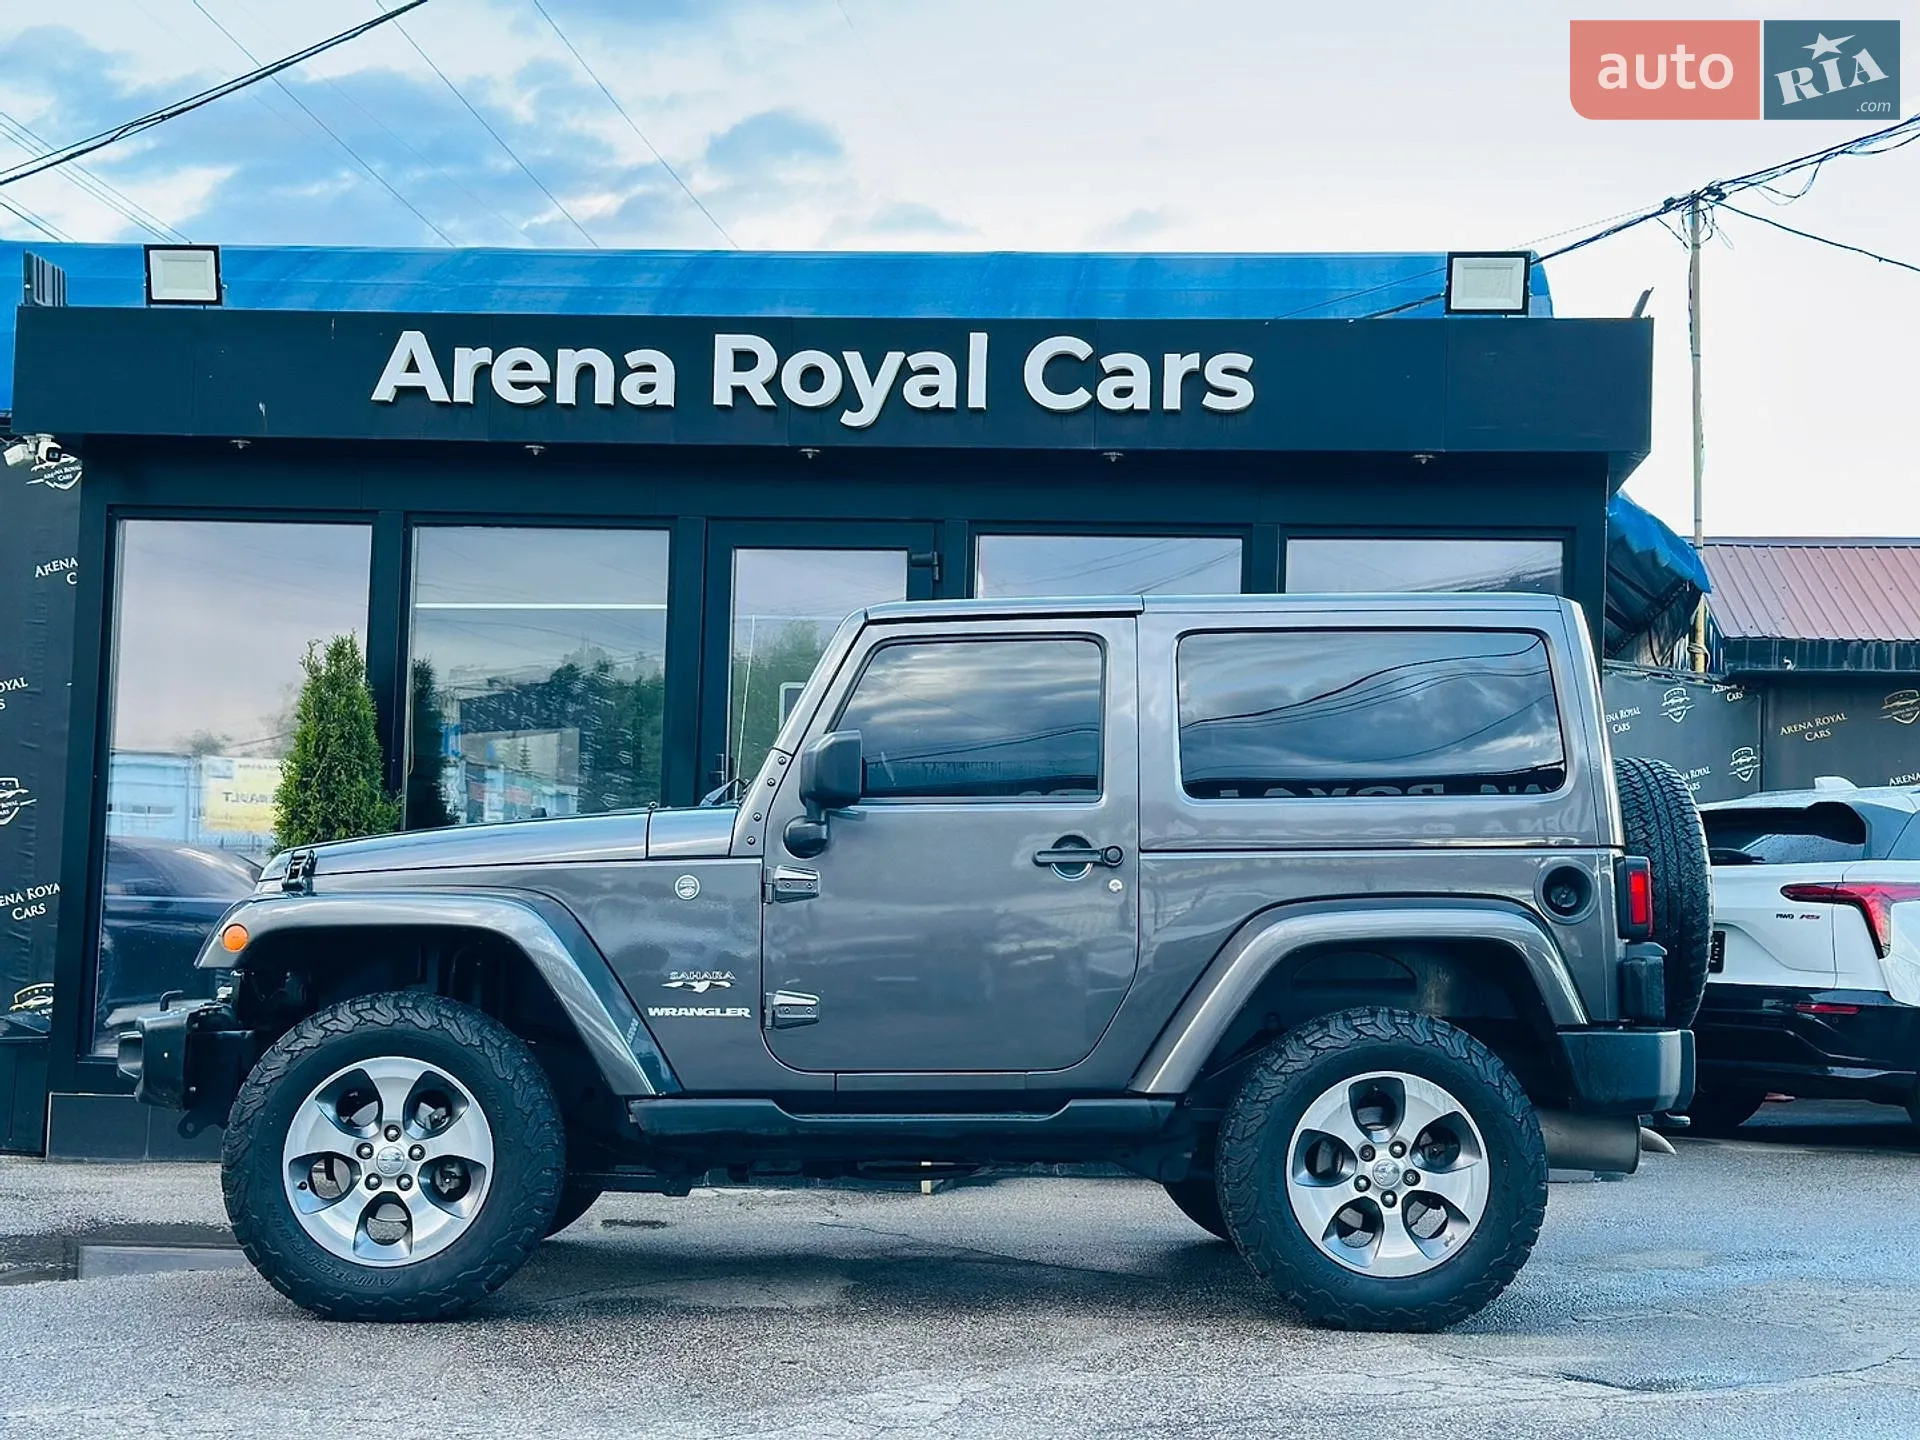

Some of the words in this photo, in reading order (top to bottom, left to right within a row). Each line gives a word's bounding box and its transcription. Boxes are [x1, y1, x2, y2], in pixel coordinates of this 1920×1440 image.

[369, 329, 676, 408] Arena
[712, 331, 989, 429] Royal
[1023, 334, 1256, 414] Cars
[34, 556, 79, 579] ARENA
[1780, 721, 1813, 736] ARENA
[1814, 712, 1848, 728] ROYAL
[1804, 728, 1832, 742] CARS
[11, 902, 47, 920] CARS
[668, 970, 737, 981] SAHARA
[647, 1007, 753, 1019] WRANGLER
